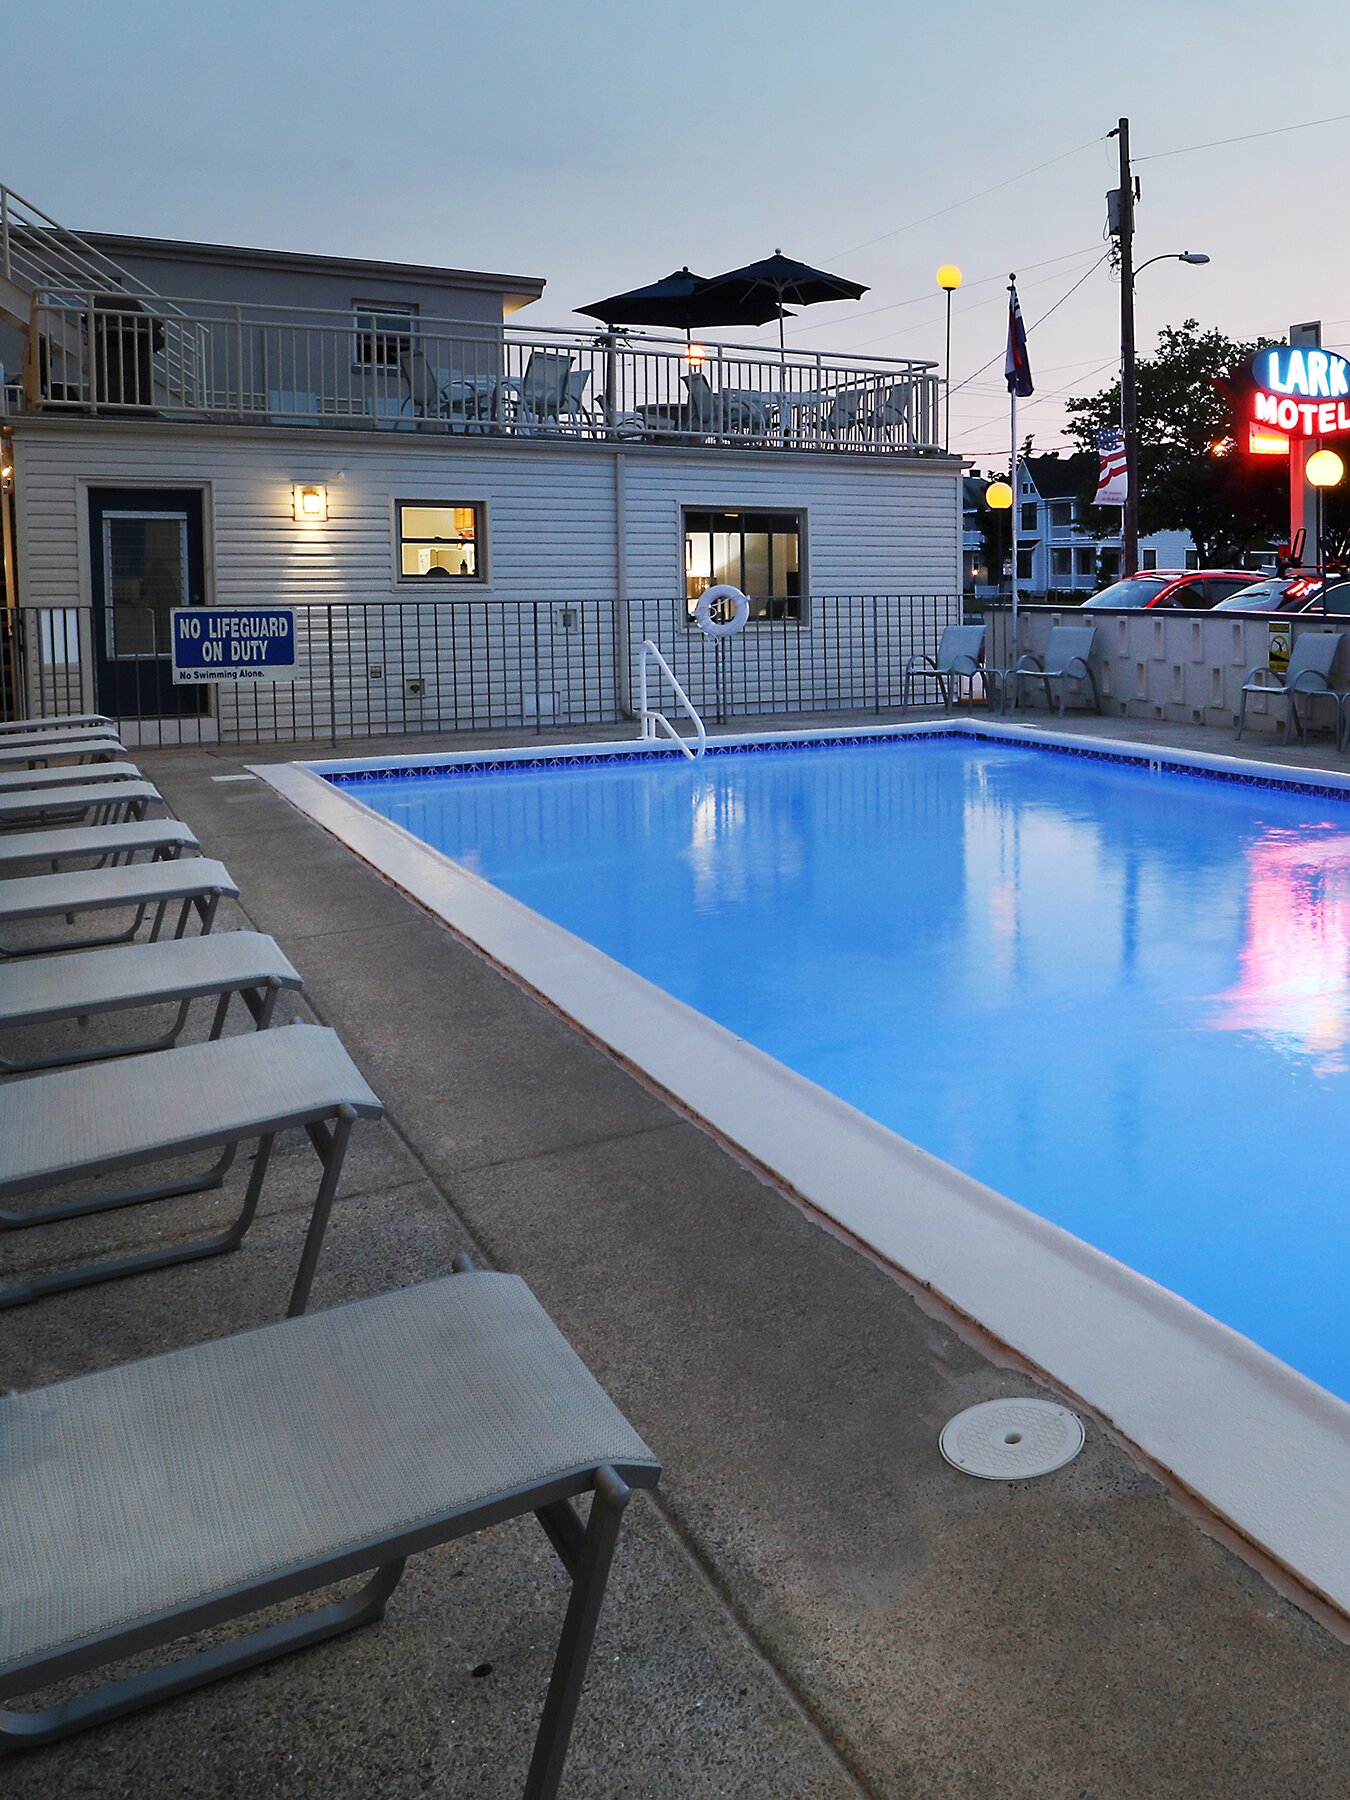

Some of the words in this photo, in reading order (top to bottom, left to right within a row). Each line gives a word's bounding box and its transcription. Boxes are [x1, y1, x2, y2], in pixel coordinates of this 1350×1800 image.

[1268, 350, 1349, 397] LARK
[179, 618, 201, 639] NO
[208, 617, 289, 638] LIFEGUARD
[202, 641, 223, 662] ON
[231, 640, 268, 661] DUTY
[179, 671, 191, 680] No
[193, 670, 238, 680] Swimming
[239, 669, 265, 678] Alone.
